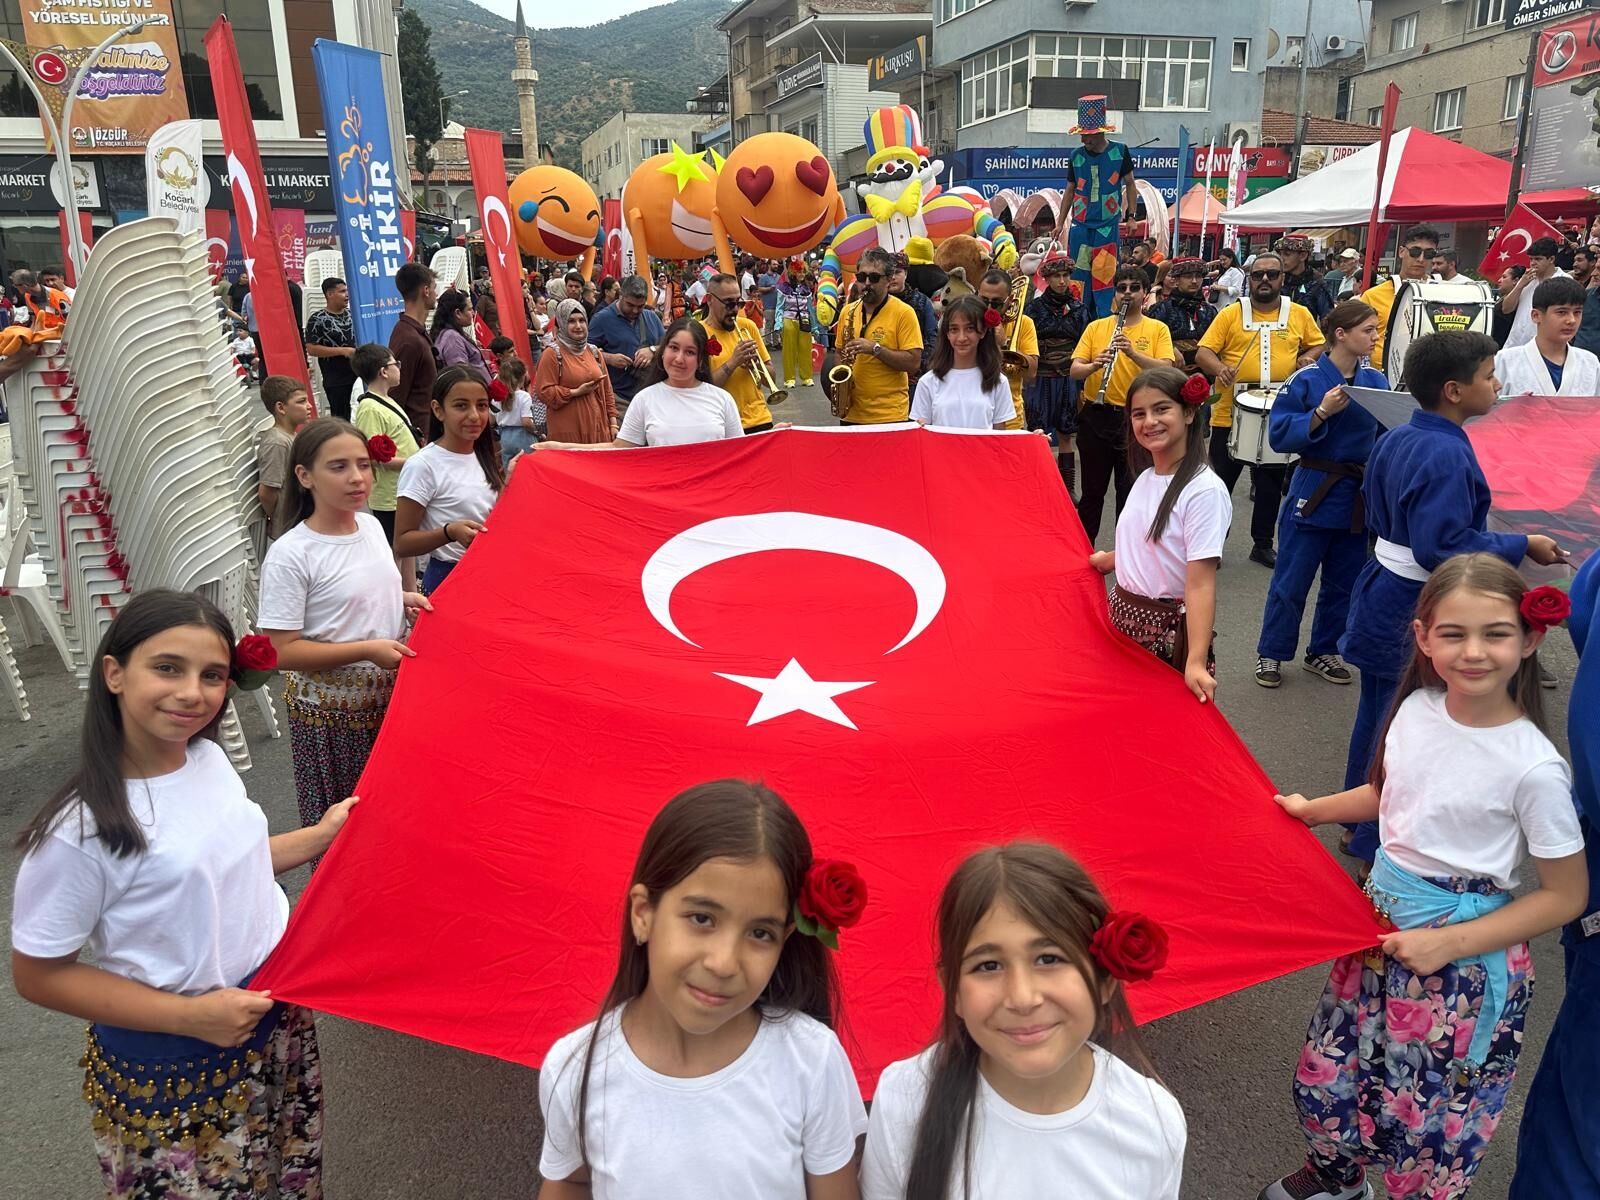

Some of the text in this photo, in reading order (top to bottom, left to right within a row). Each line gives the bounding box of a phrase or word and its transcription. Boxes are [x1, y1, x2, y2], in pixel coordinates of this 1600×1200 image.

[29, 9, 169, 25] YÖRESEL ÜRÜNLER
[1513, 13, 1541, 26] ÖMER
[1542, 0, 1582, 18] SİNİKAN
[96, 48, 168, 70] alimize
[884, 48, 915, 74] KIRKUŞU
[80, 74, 164, 96] oşgeldiniz
[95, 126, 128, 140] ÖZGÜR
[985, 155, 1069, 172] ŞAHİNCİ MARKE
[1143, 157, 1178, 169] MARKE
[1196, 154, 1248, 172] GNYN
[0, 174, 46, 186] MARKET
[279, 174, 331, 187] MARKET
[369, 160, 401, 277] FİKİR
